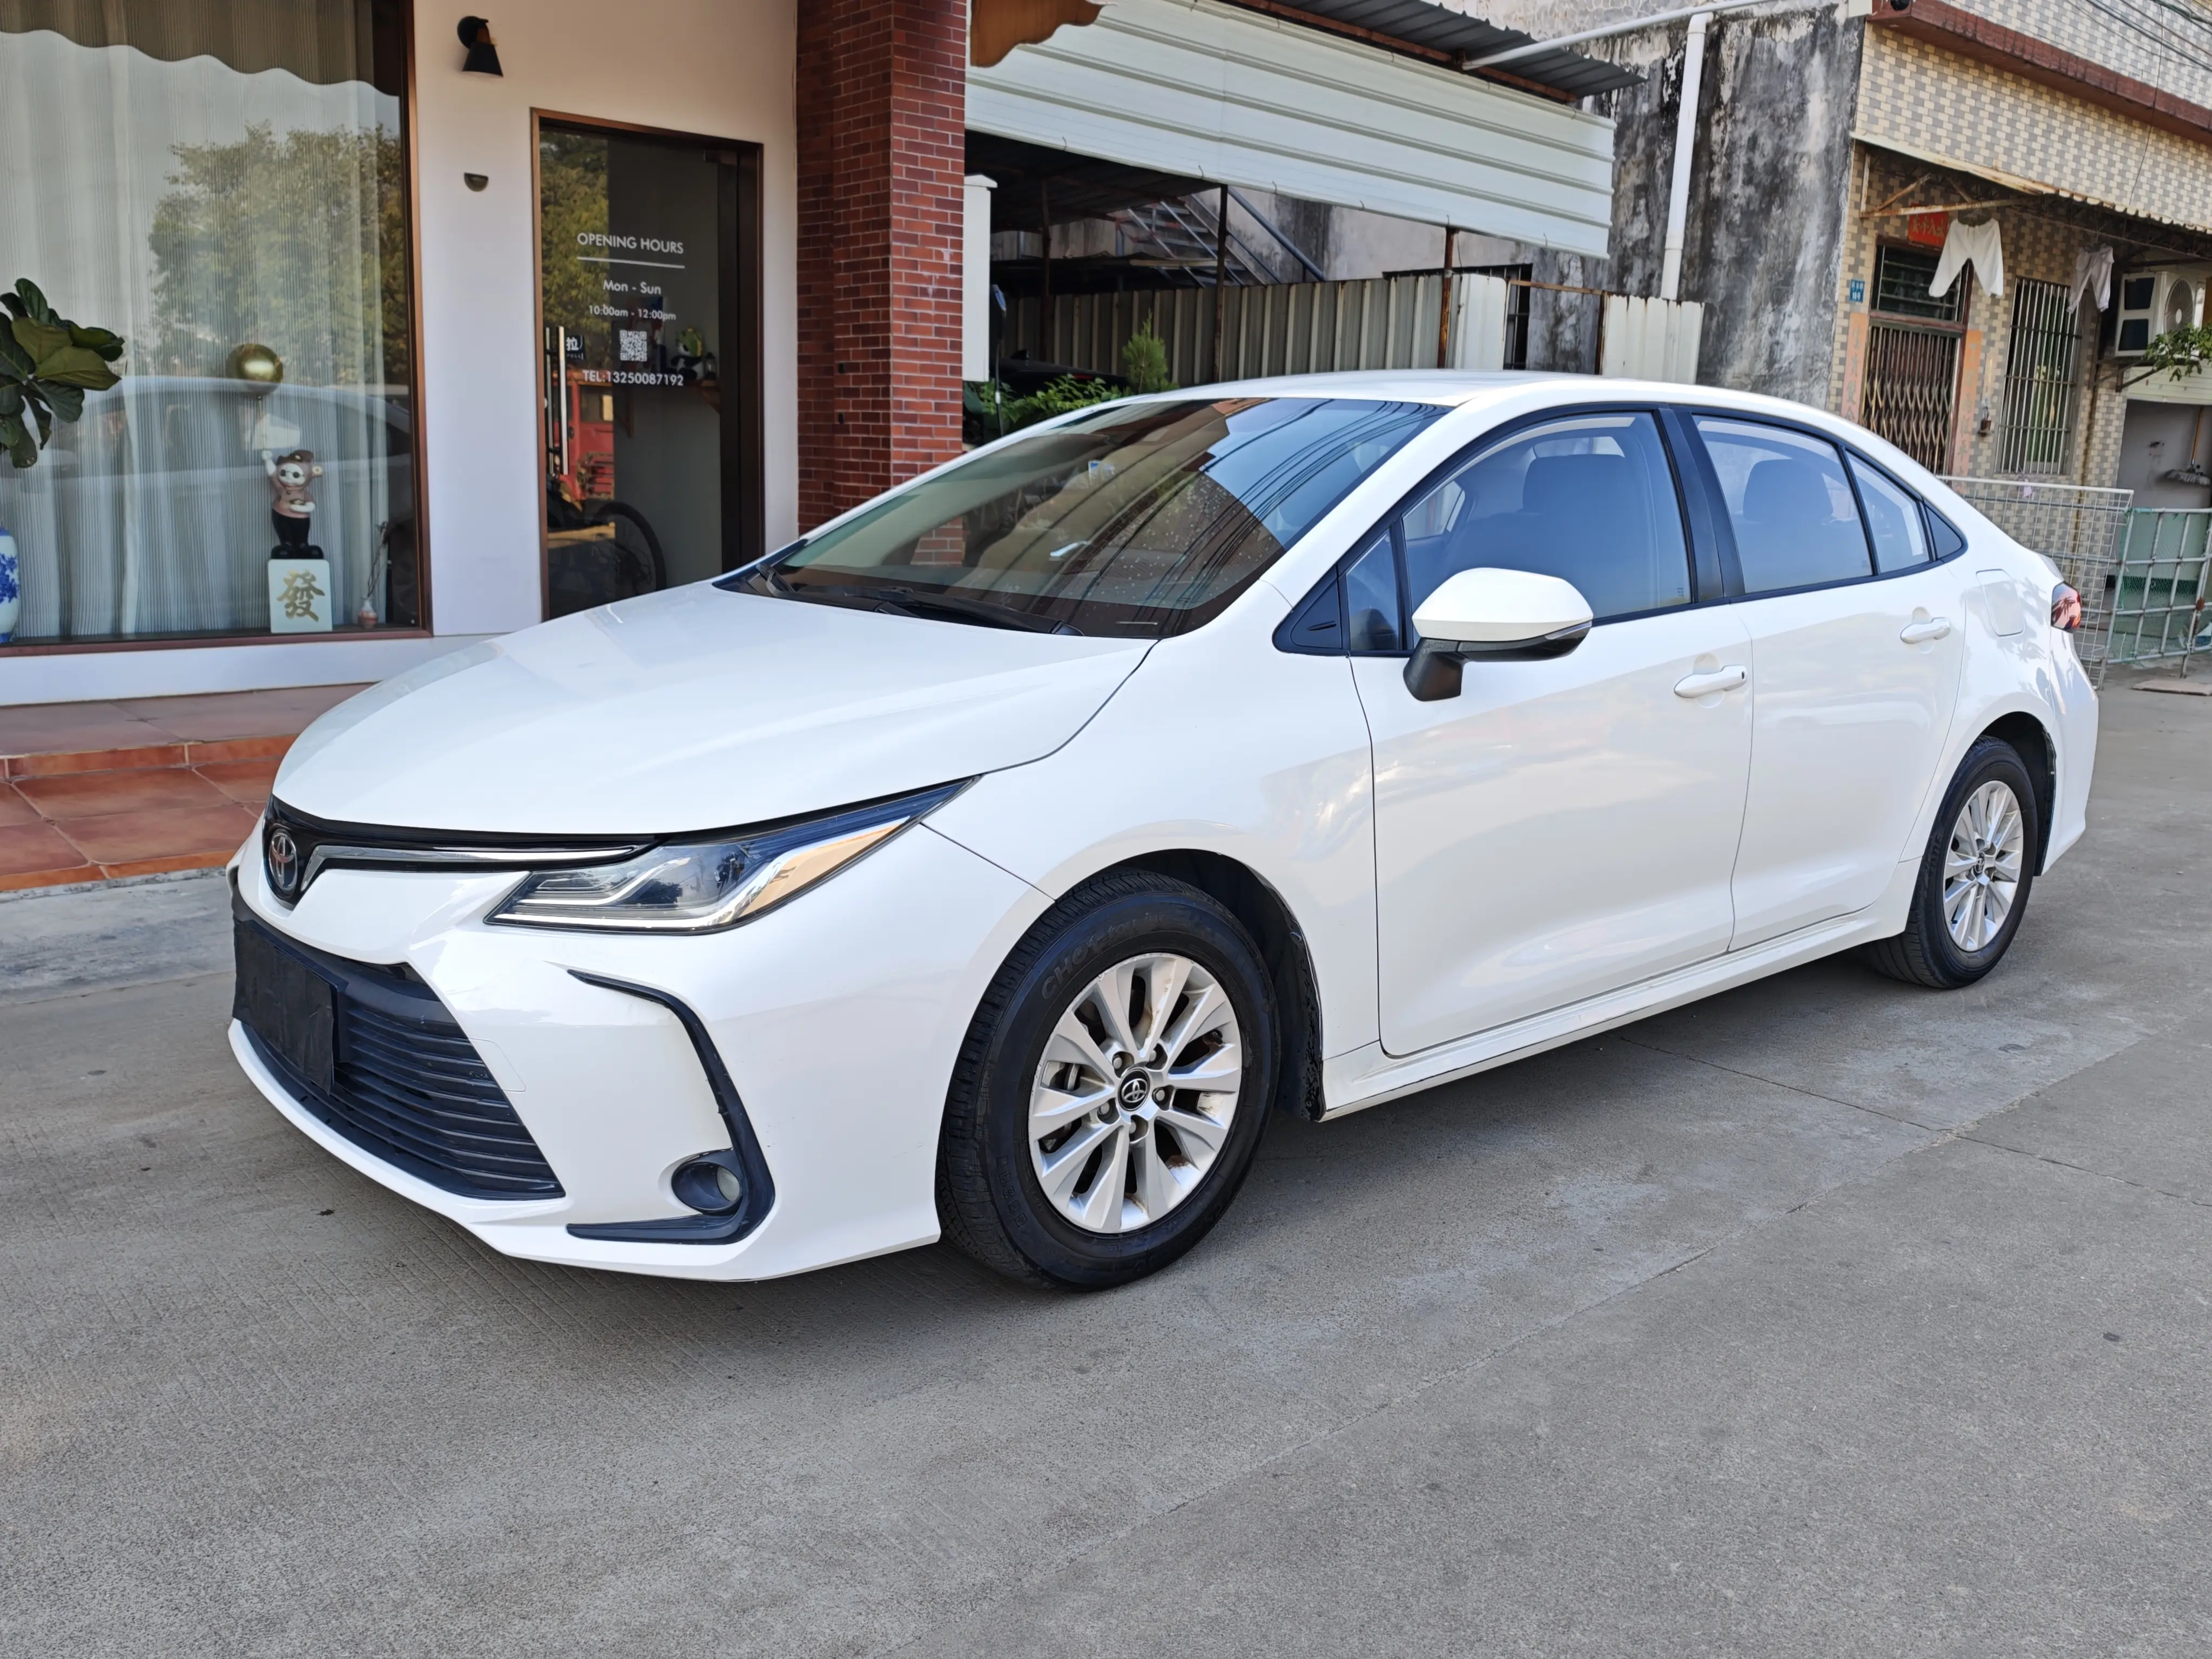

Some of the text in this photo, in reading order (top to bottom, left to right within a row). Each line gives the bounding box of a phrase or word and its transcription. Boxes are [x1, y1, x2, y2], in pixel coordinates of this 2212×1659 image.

[577, 232, 684, 254] OPENING HOURS
[603, 279, 629, 292] Mon
[640, 281, 662, 295] Sun
[589, 304, 629, 317] 10:00am
[638, 308, 676, 321] 12:00pm
[566, 336, 579, 351] 拉
[583, 369, 684, 387] TEL:13250087192
[277, 568, 325, 623] 發
